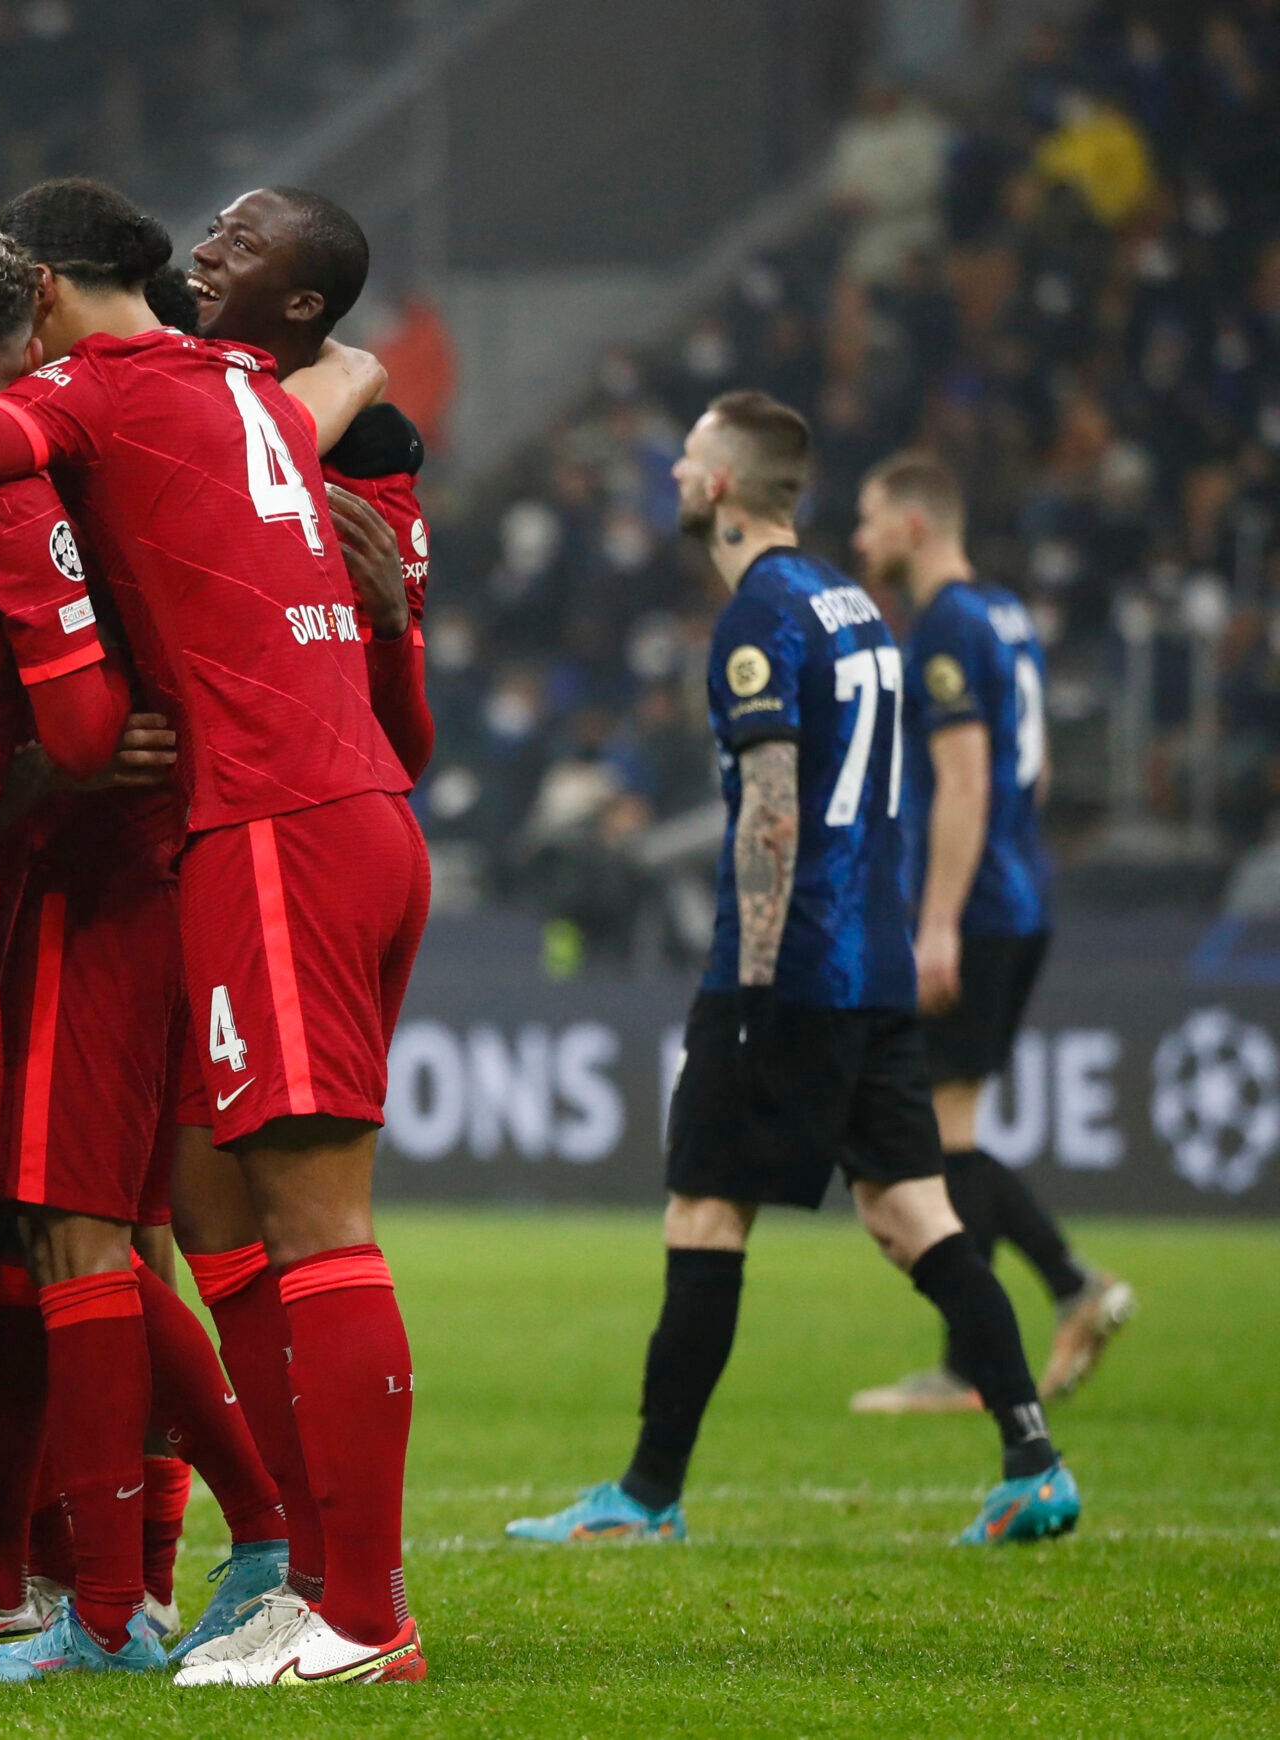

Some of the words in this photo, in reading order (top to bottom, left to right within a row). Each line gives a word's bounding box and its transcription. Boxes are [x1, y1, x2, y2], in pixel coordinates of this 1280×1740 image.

[224, 367, 325, 557] 4
[285, 604, 332, 645] SIDE
[825, 646, 904, 826] 77
[209, 985, 247, 1072] 4
